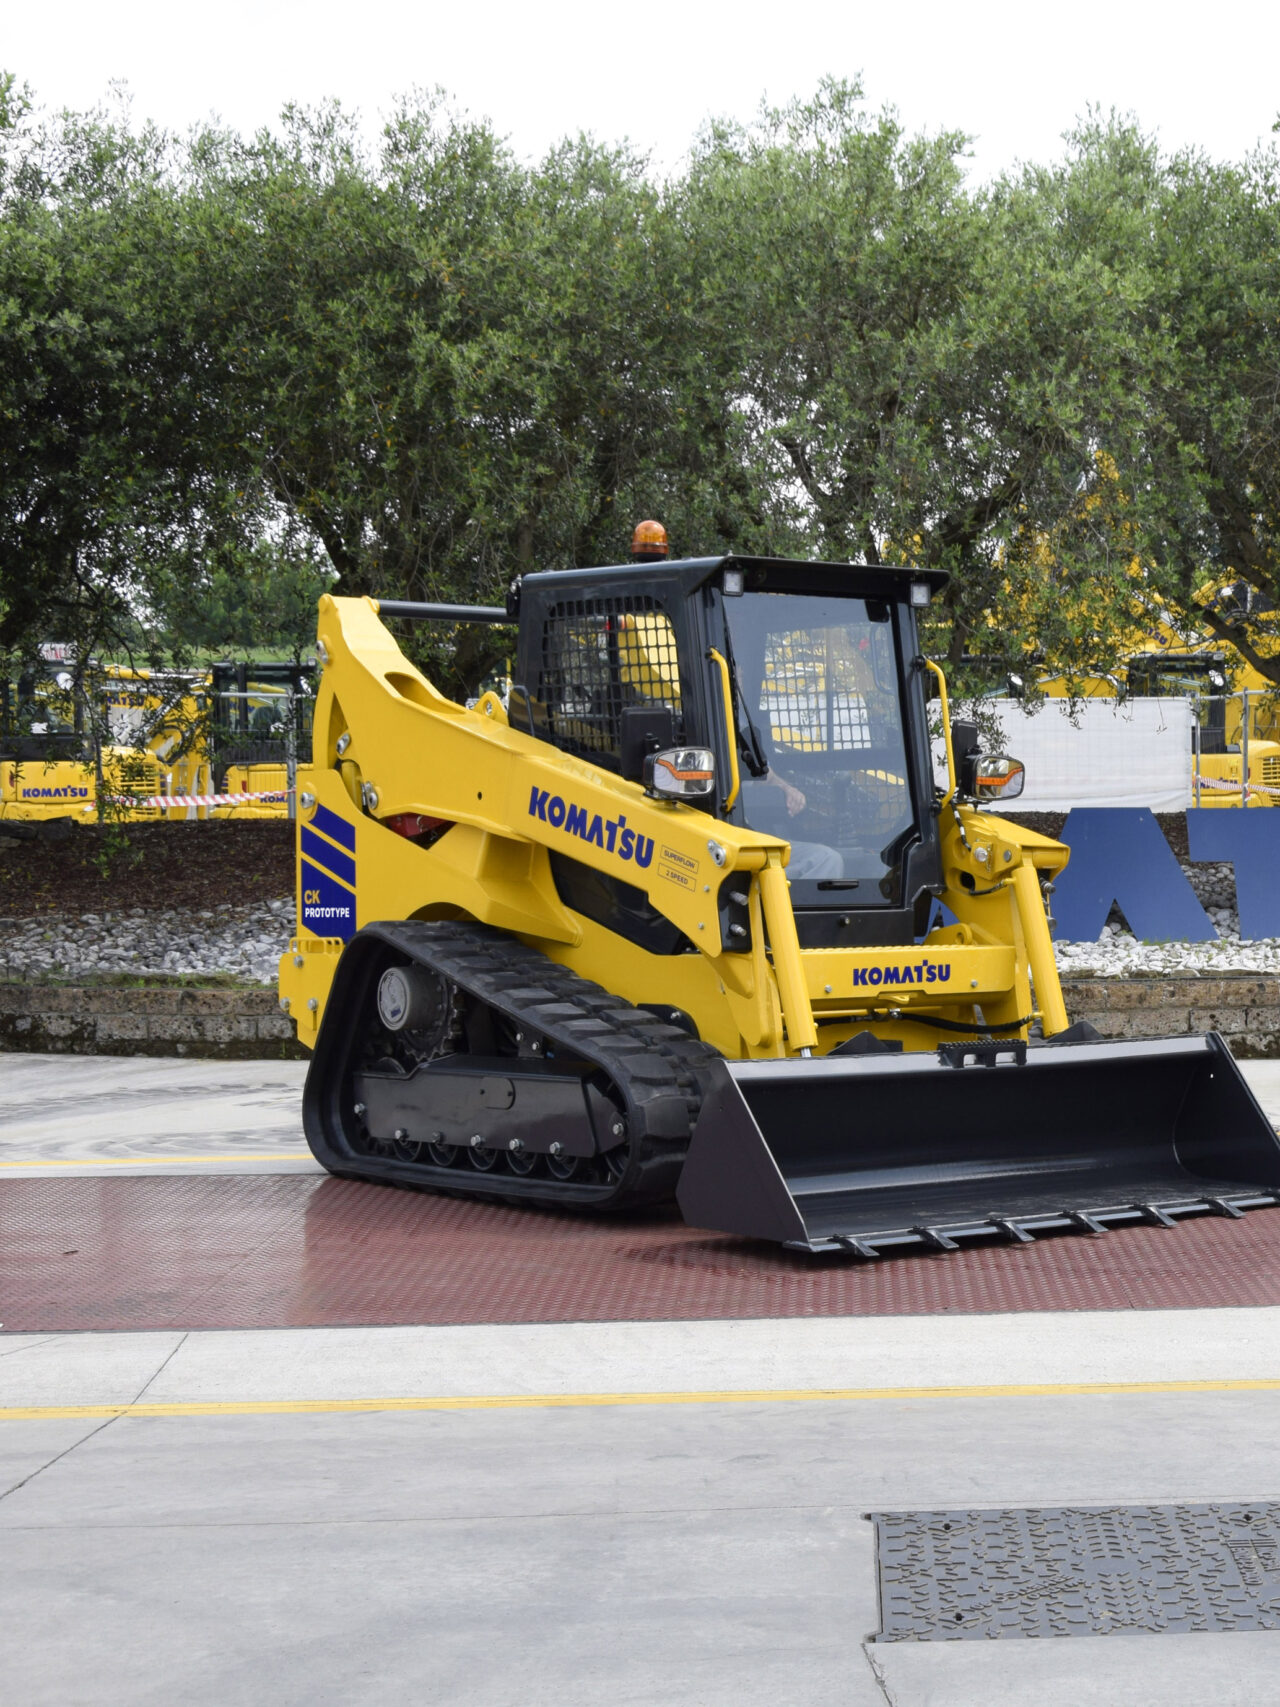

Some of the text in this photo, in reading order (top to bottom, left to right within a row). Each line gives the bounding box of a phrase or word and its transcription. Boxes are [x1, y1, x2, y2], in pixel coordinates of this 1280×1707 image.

[22, 785, 88, 798] KOMATSU
[528, 786, 655, 868] KOMATSU
[663, 850, 696, 869] SUPERFLOW
[670, 871, 688, 885] SPEED
[304, 889, 320, 904] CK
[305, 907, 350, 918] PROTOTYPE
[853, 959, 951, 986] KOMATSU
